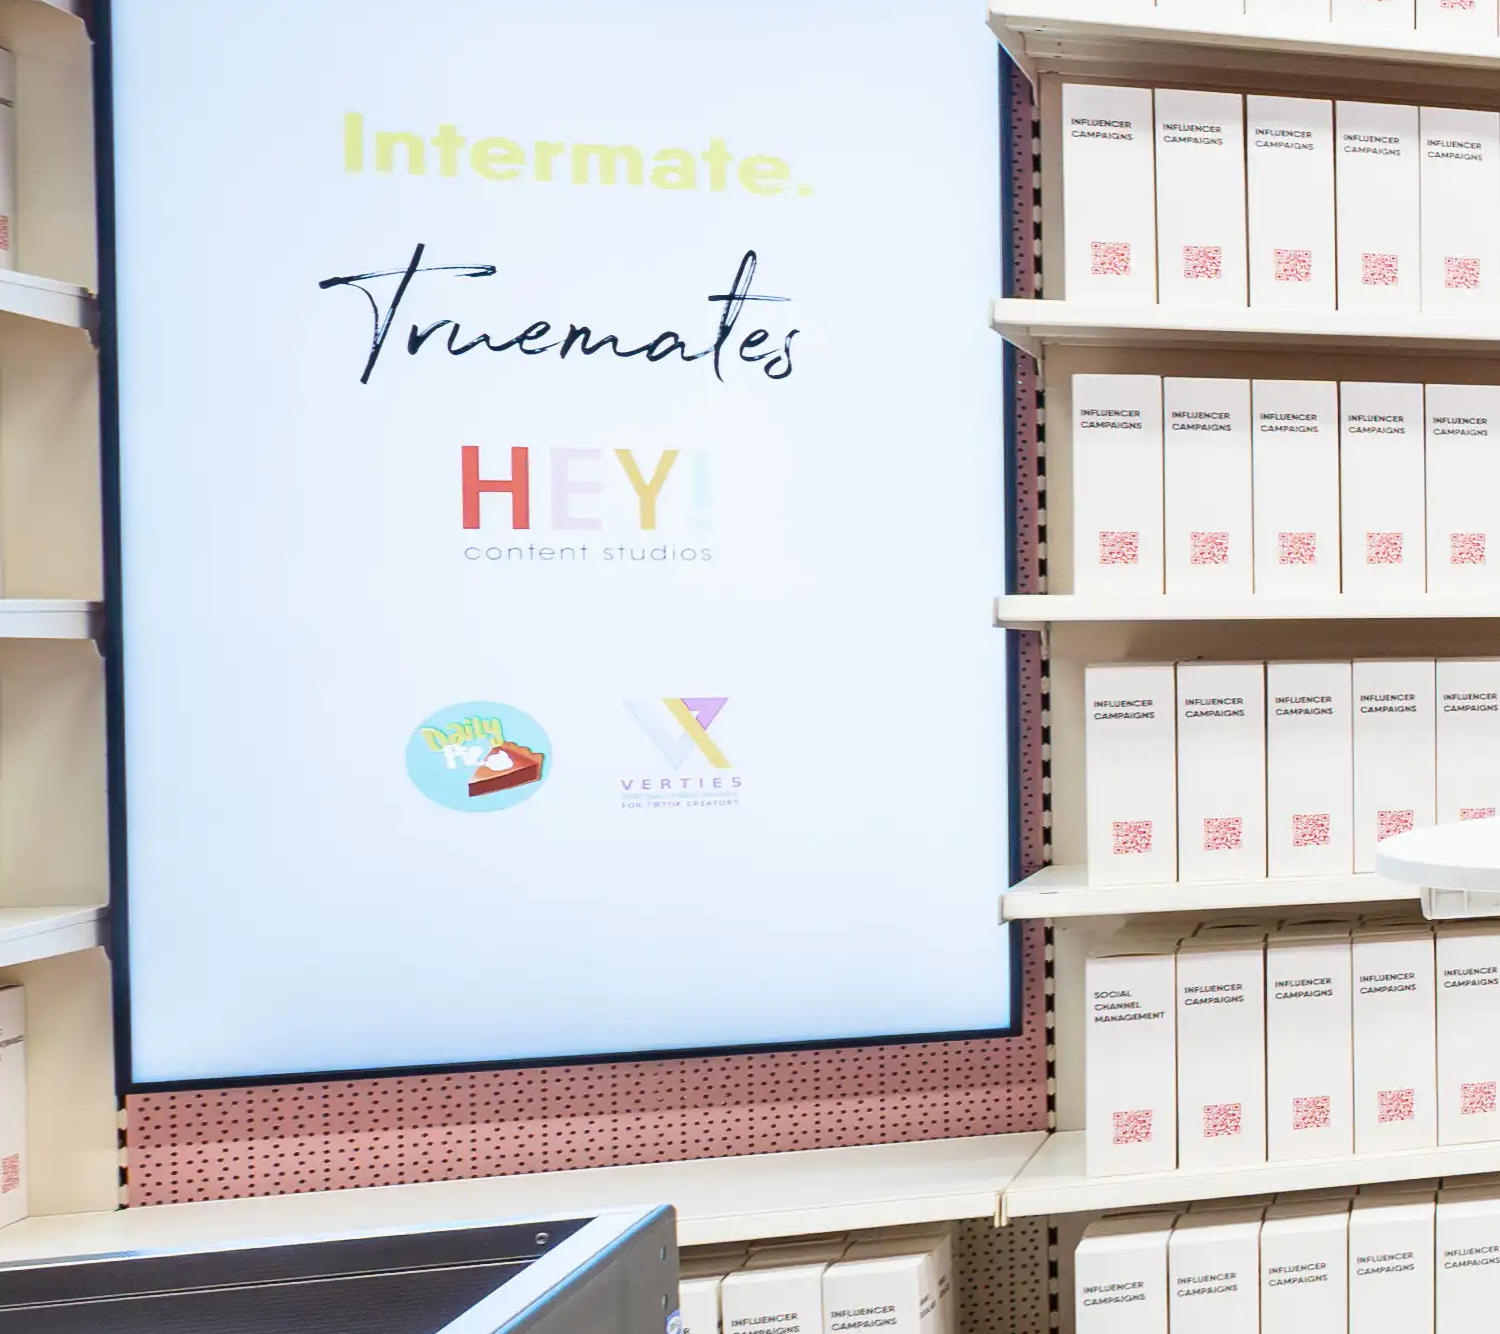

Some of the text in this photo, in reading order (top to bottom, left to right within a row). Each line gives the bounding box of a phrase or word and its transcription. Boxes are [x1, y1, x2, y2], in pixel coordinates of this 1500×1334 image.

[1071, 118, 1132, 129] INFLUENCER
[1071, 130, 1134, 141] CAMPAIGNS
[344, 113, 813, 194] Intermate.
[319, 243, 802, 384] Truemates
[1172, 411, 1230, 419] INFLUENCER
[1172, 423, 1232, 432] CAMPAIGNS
[462, 445, 713, 530] HEY!
[464, 543, 713, 561] content studios
[1360, 693, 1416, 702] INFLUENCER
[1094, 699, 1153, 708] INFLUENCER
[1360, 705, 1417, 713] CAMPAIGNS
[1094, 711, 1155, 720] CAMPAIGNS
[420, 716, 506, 752] Daily
[621, 776, 743, 790] VERTIES
[1274, 977, 1332, 987] INFLUENCER
[1094, 990, 1132, 999] SOCIAL
[1274, 989, 1333, 999] CAMPAIGNS
[1094, 1001, 1141, 1011] CHANNEL
[1094, 1011, 1165, 1023] MANAGEMENT
[1177, 1272, 1236, 1285] INFLUENCER
[1176, 1284, 1238, 1297] CAMPAIGNS
[830, 1305, 895, 1318] INFLUENCER
[832, 1317, 898, 1331] CAMPAIGNS
